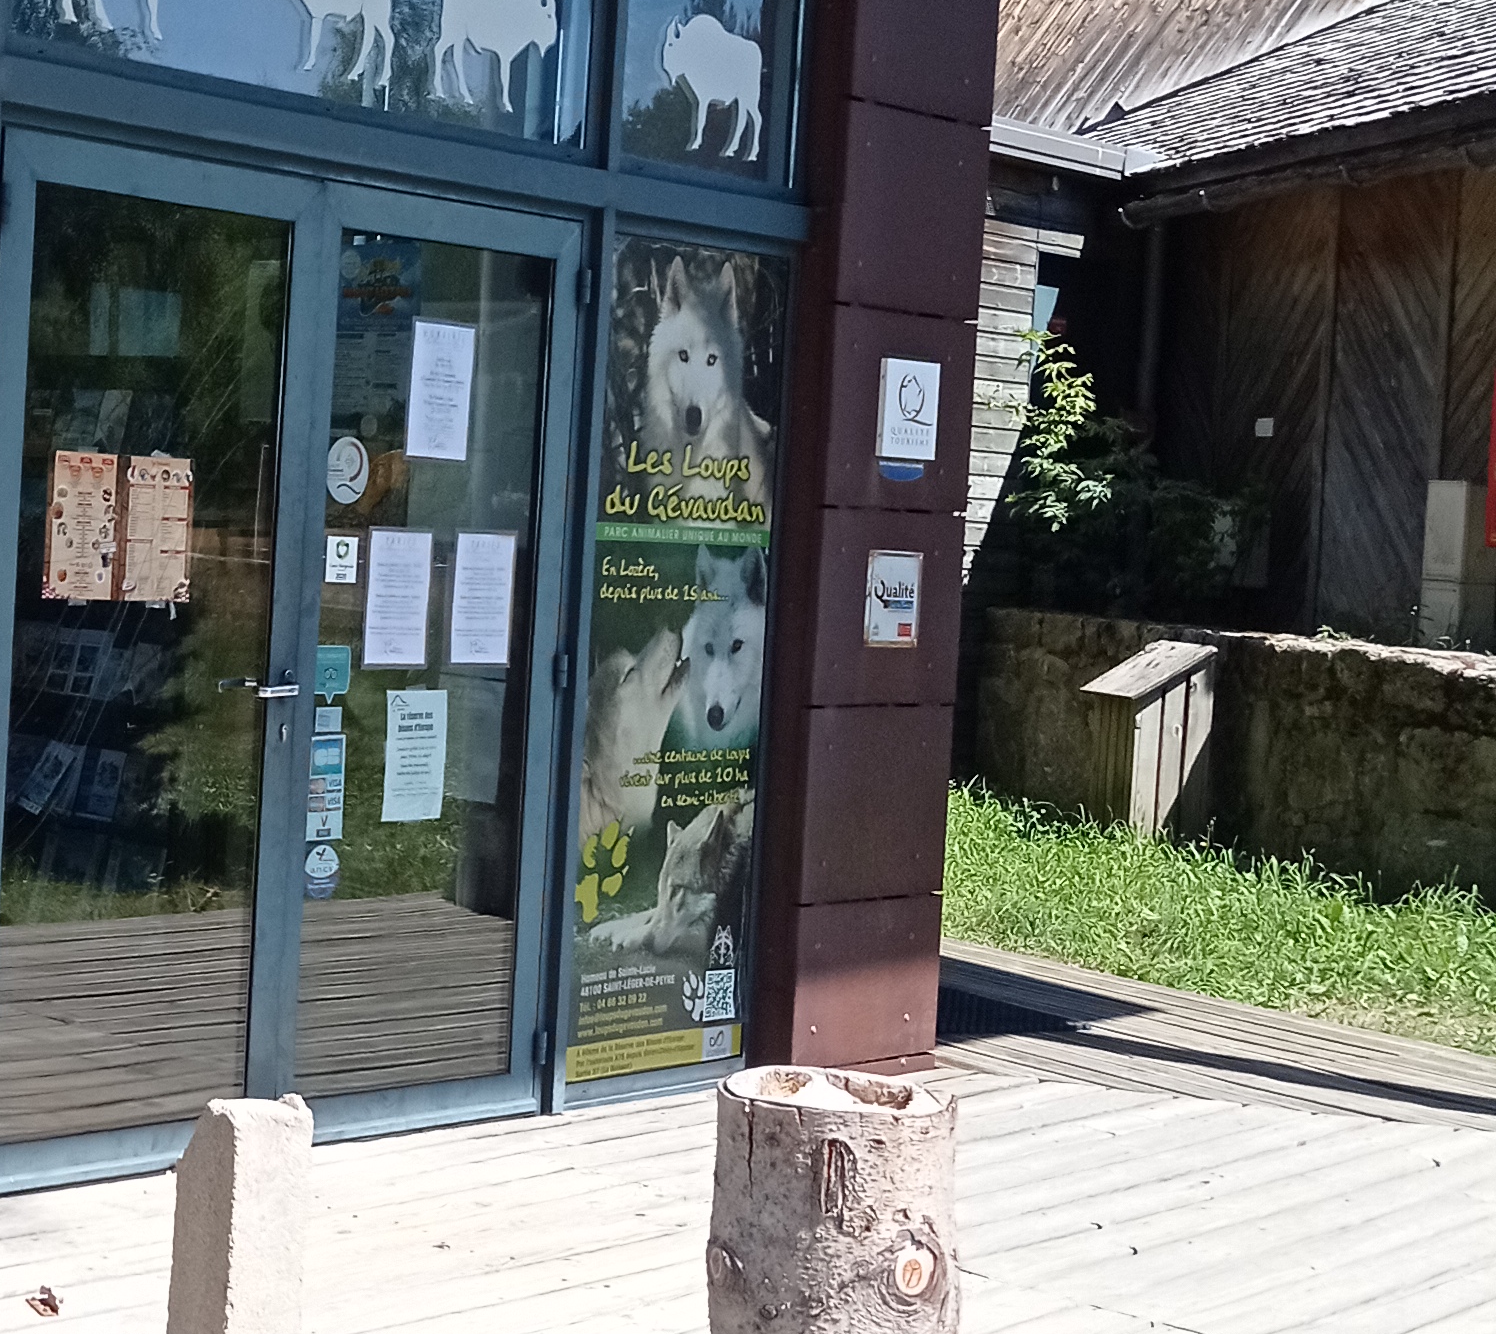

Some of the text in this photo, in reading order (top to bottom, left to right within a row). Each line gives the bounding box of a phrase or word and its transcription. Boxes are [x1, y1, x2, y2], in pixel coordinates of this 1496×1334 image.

[627, 441, 751, 487] Les Loups
[605, 484, 765, 522] du Gévaudan
[604, 526, 762, 544] PARC ANIMALIER UNIQUE AU MONDE
[602, 555, 617, 576] En
[599, 582, 637, 603] depuis
[639, 584, 663, 603] plus
[664, 585, 679, 600] de
[874, 579, 914, 604] Qualité
[664, 748, 707, 763] centaine
[710, 749, 723, 761] de
[329, 779, 342, 787] VISA
[674, 770, 697, 789] plus
[698, 770, 712, 783] de
[735, 768, 749, 782] ha
[327, 797, 341, 806] VISA
[660, 795, 673, 808] en
